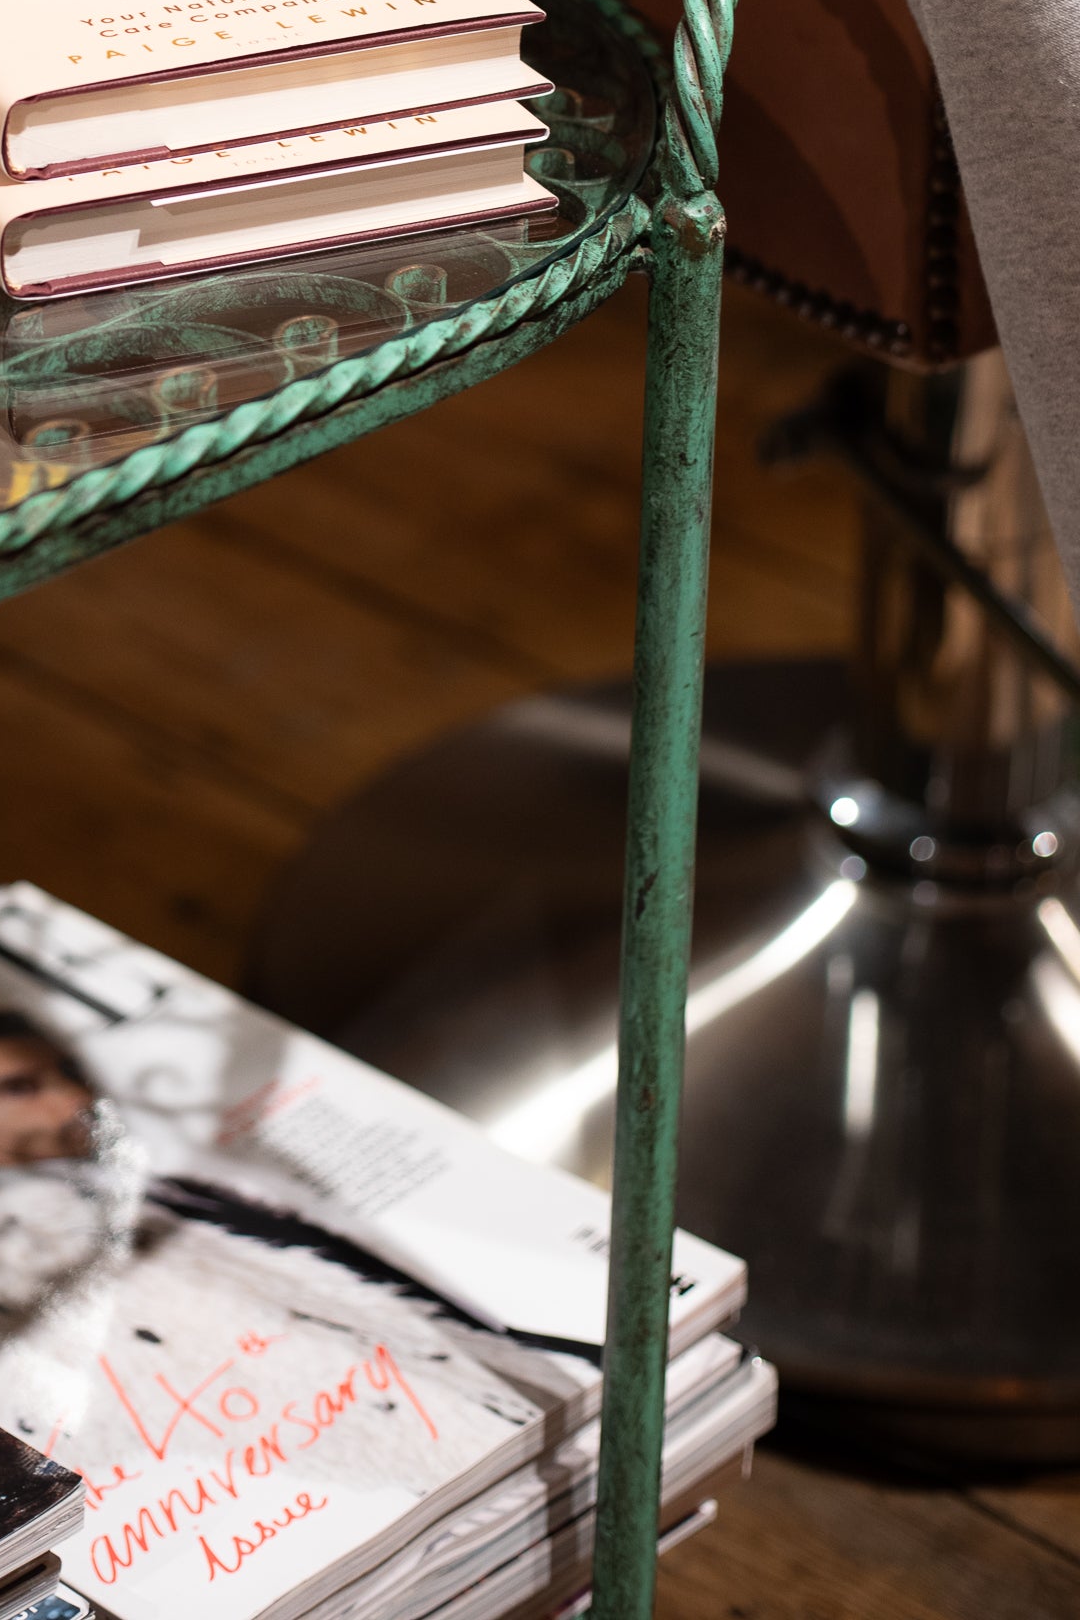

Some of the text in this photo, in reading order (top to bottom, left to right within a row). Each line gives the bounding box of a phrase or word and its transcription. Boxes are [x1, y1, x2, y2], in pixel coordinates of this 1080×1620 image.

[79, 9, 148, 27] Your
[99, 19, 179, 40] Care
[67, 29, 233, 65] PAIGE
[277, 114, 438, 148] LEWIN
[90, 1343, 439, 1584] anniversary
[193, 1491, 328, 1581] issue
